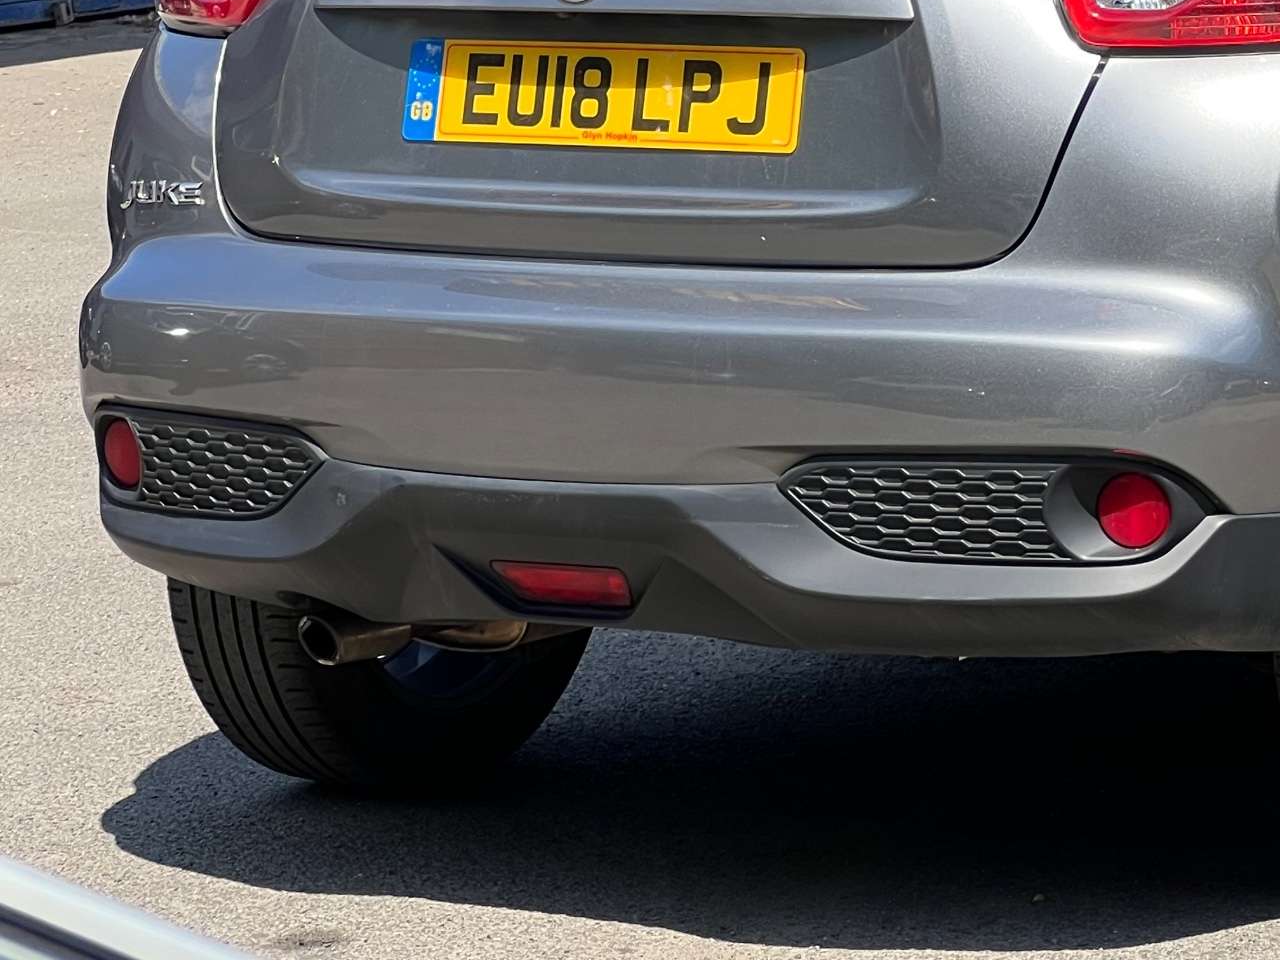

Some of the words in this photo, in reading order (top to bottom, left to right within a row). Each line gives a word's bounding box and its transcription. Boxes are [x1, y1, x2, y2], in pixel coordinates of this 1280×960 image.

[462, 52, 612, 130] EU18
[631, 57, 772, 136] LPJ
[410, 100, 434, 121] GB
[120, 179, 206, 209] JUKE
